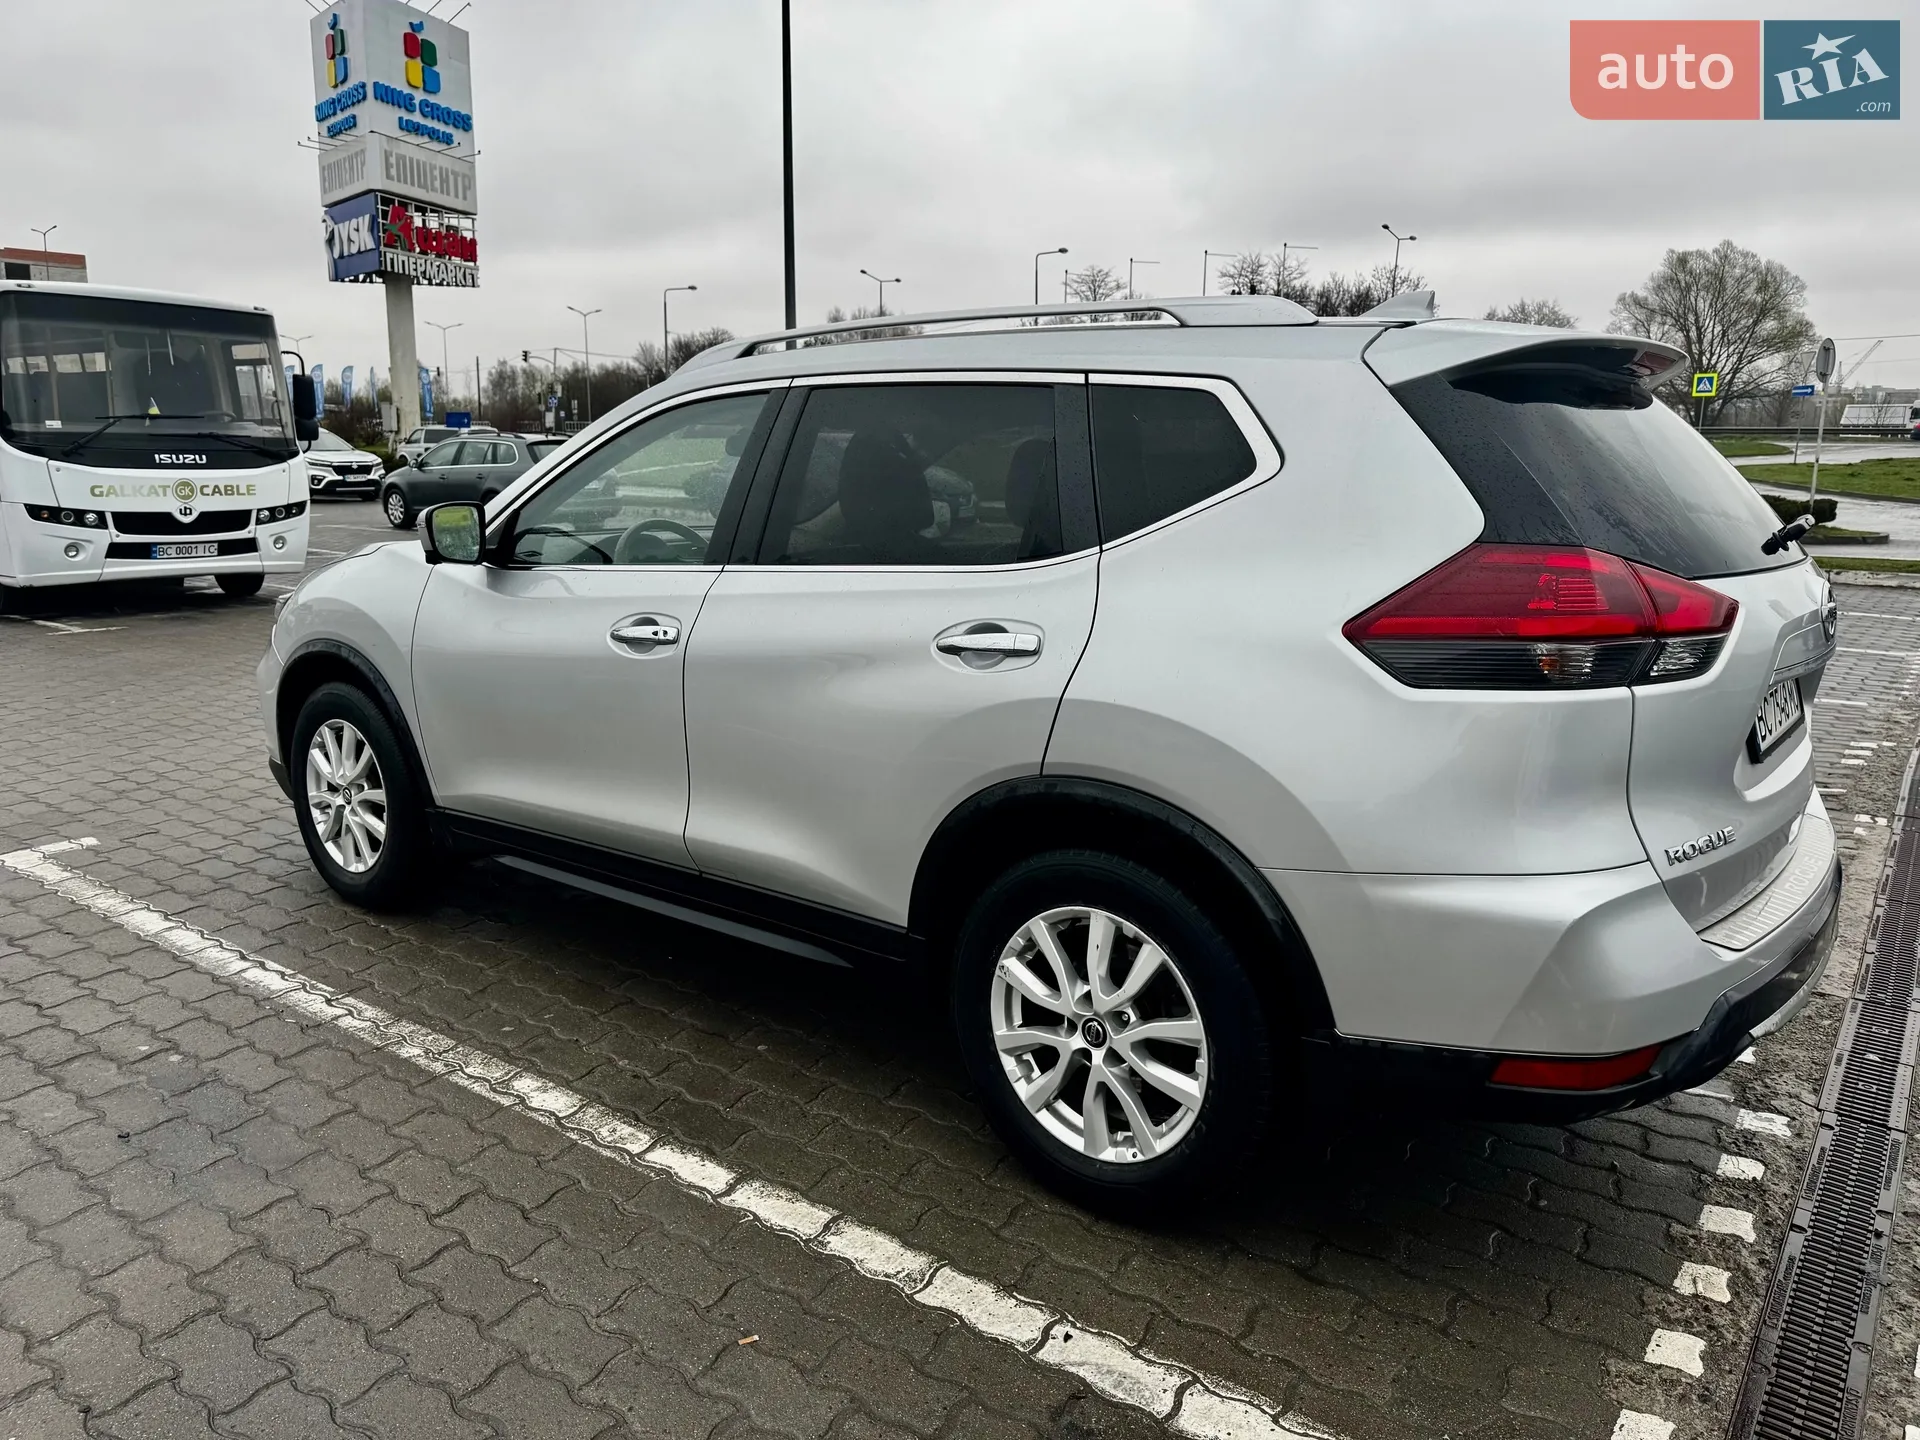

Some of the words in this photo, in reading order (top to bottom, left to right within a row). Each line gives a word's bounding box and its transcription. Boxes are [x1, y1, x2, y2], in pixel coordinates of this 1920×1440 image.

[315, 96, 337, 122] KING
[335, 81, 367, 112] CROSS
[373, 81, 417, 113] KING
[418, 98, 473, 132] CROSS
[398, 116, 454, 146] LEOPOLIS
[321, 149, 366, 195] ЕПІЦЕНТР
[383, 149, 472, 201] ЕПІЦЕНТР
[332, 213, 377, 260] JYSK
[386, 252, 480, 289] ГІПЕРМАРКЕТ
[154, 453, 207, 464] ISUZU
[89, 484, 170, 498] GALKAT
[176, 484, 193, 497] GK
[199, 484, 257, 497] CABLE
[157, 546, 173, 557] BC
[175, 545, 198, 556] 0001
[1664, 825, 1737, 867] ROGUE
[1784, 856, 1823, 894] ROGUE
